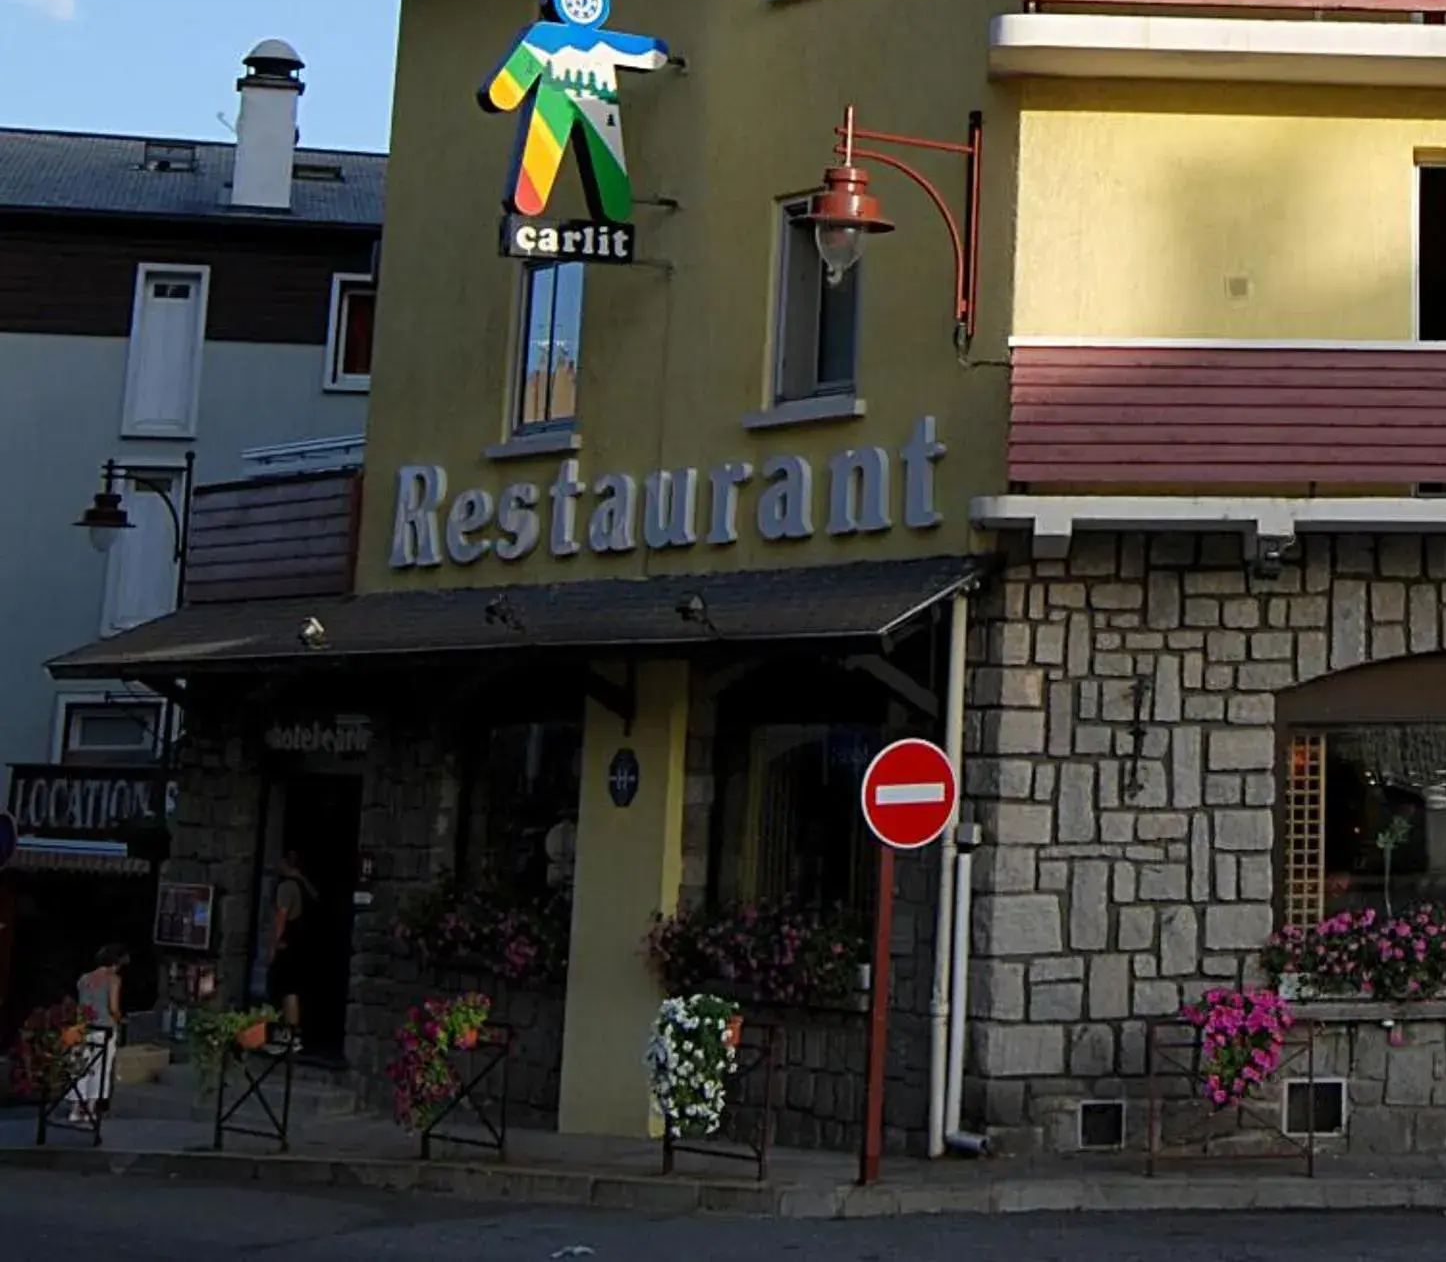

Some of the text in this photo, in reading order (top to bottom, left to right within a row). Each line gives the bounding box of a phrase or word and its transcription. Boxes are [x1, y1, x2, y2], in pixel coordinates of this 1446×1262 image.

[514, 225, 629, 257] carlit
[389, 415, 947, 569] Restaurant
[14, 776, 156, 830] LOCATION
